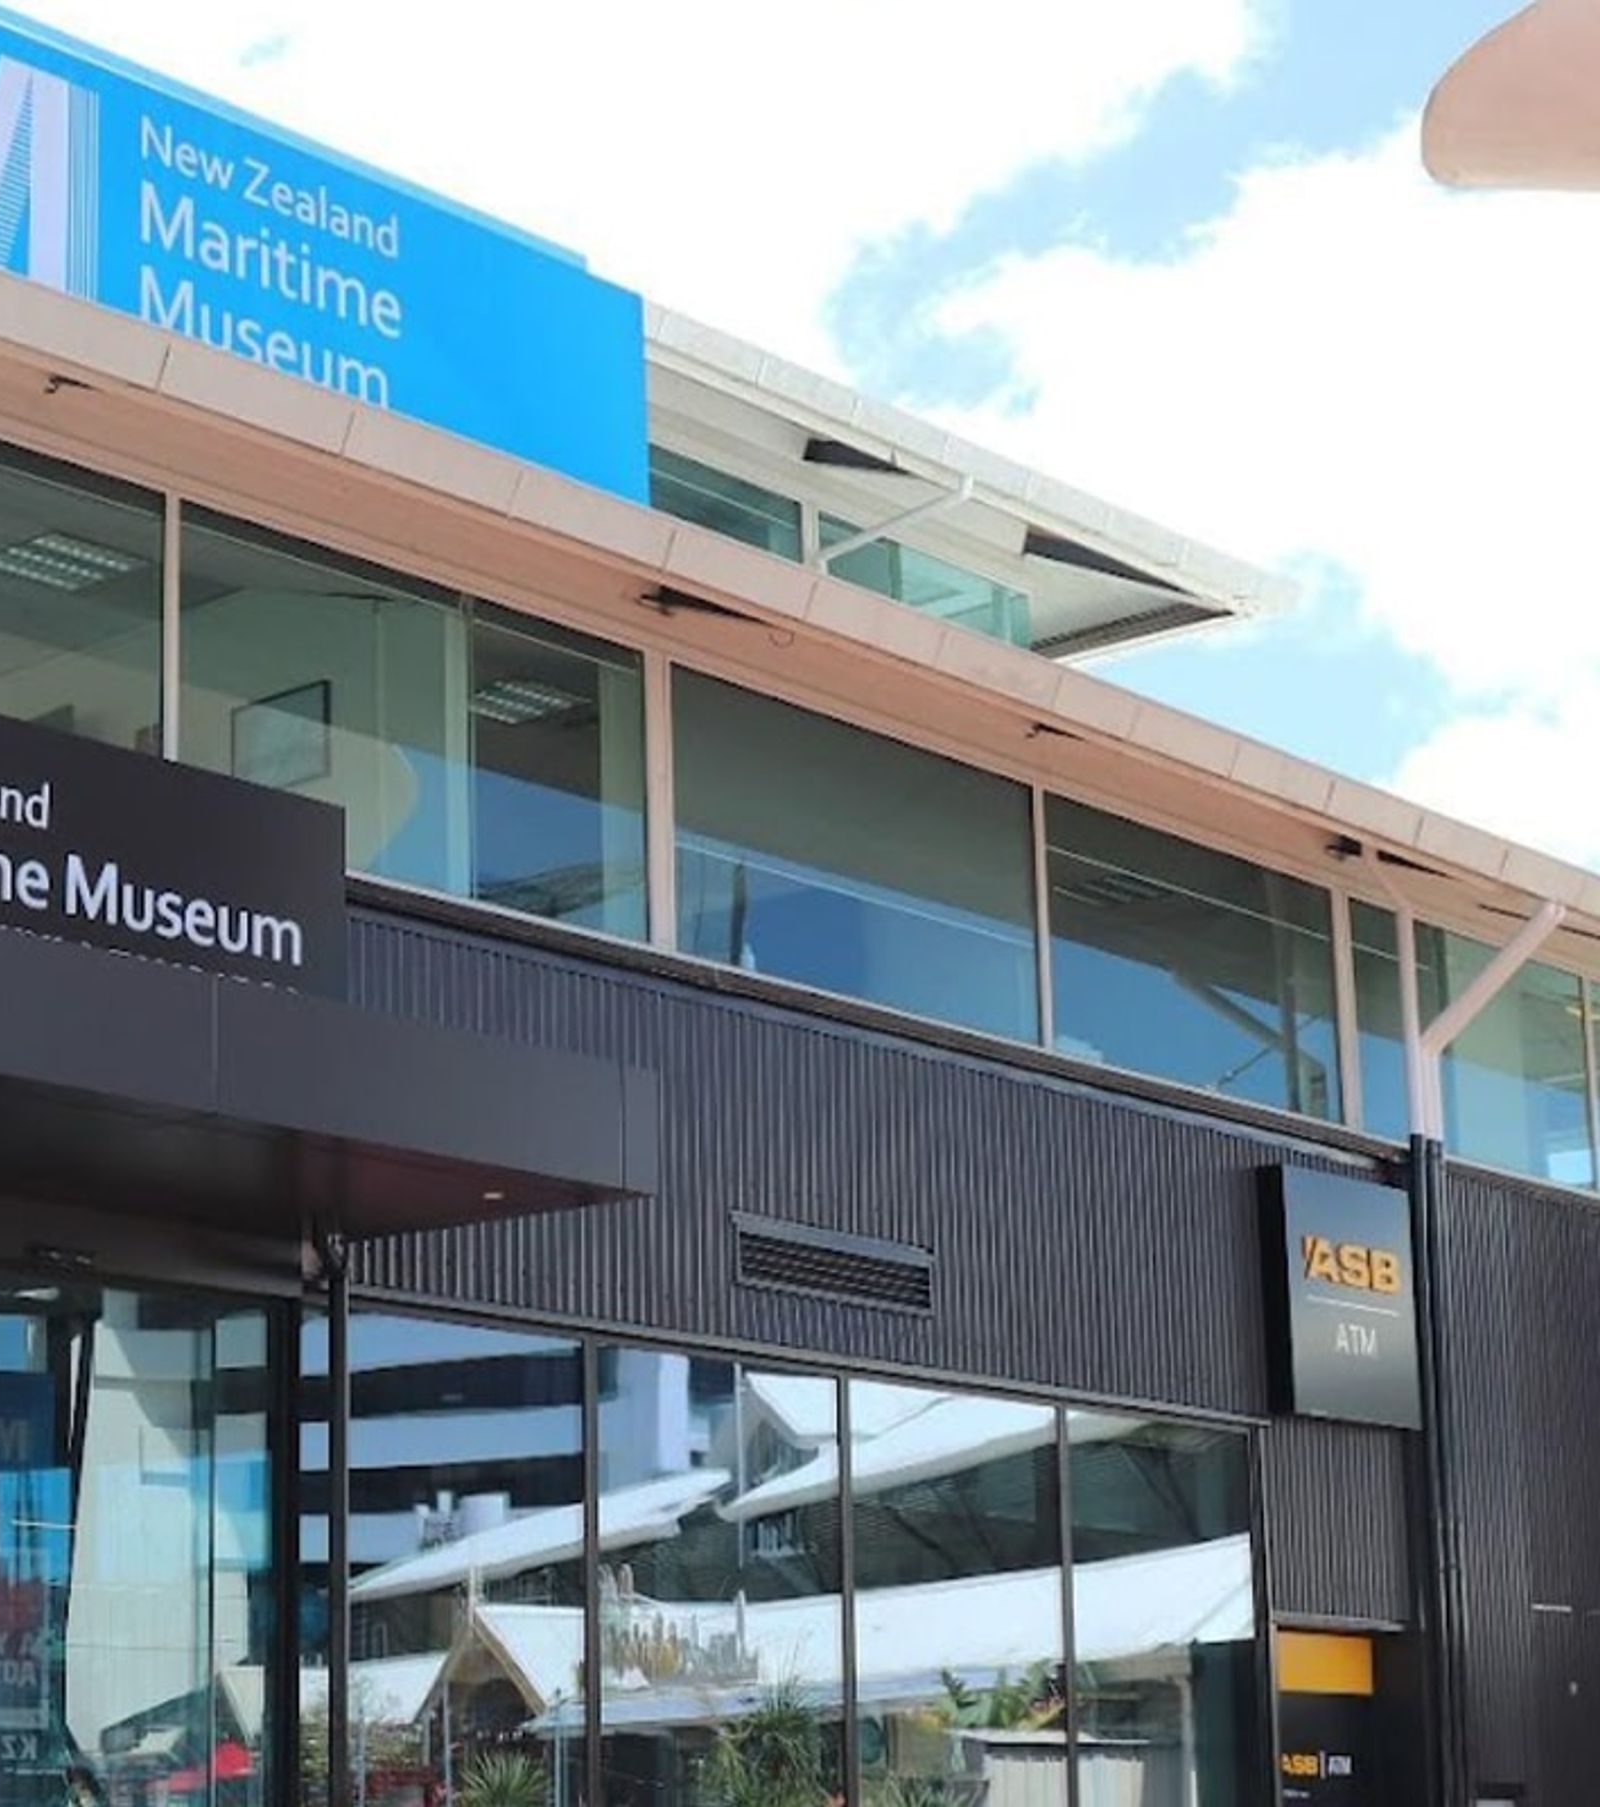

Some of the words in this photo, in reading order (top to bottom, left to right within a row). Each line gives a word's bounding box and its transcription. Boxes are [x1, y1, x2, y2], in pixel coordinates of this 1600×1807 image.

[140, 115, 233, 189] New
[243, 160, 398, 258] Zealand
[140, 183, 401, 338] Maritime
[139, 265, 389, 410] Museum
[65, 854, 303, 966] Museum
[1303, 1236, 1399, 1295] ASB
[1337, 1323, 1377, 1357] ATM
[1280, 1753, 1319, 1776] ASB
[1328, 1755, 1352, 1776] ATM
